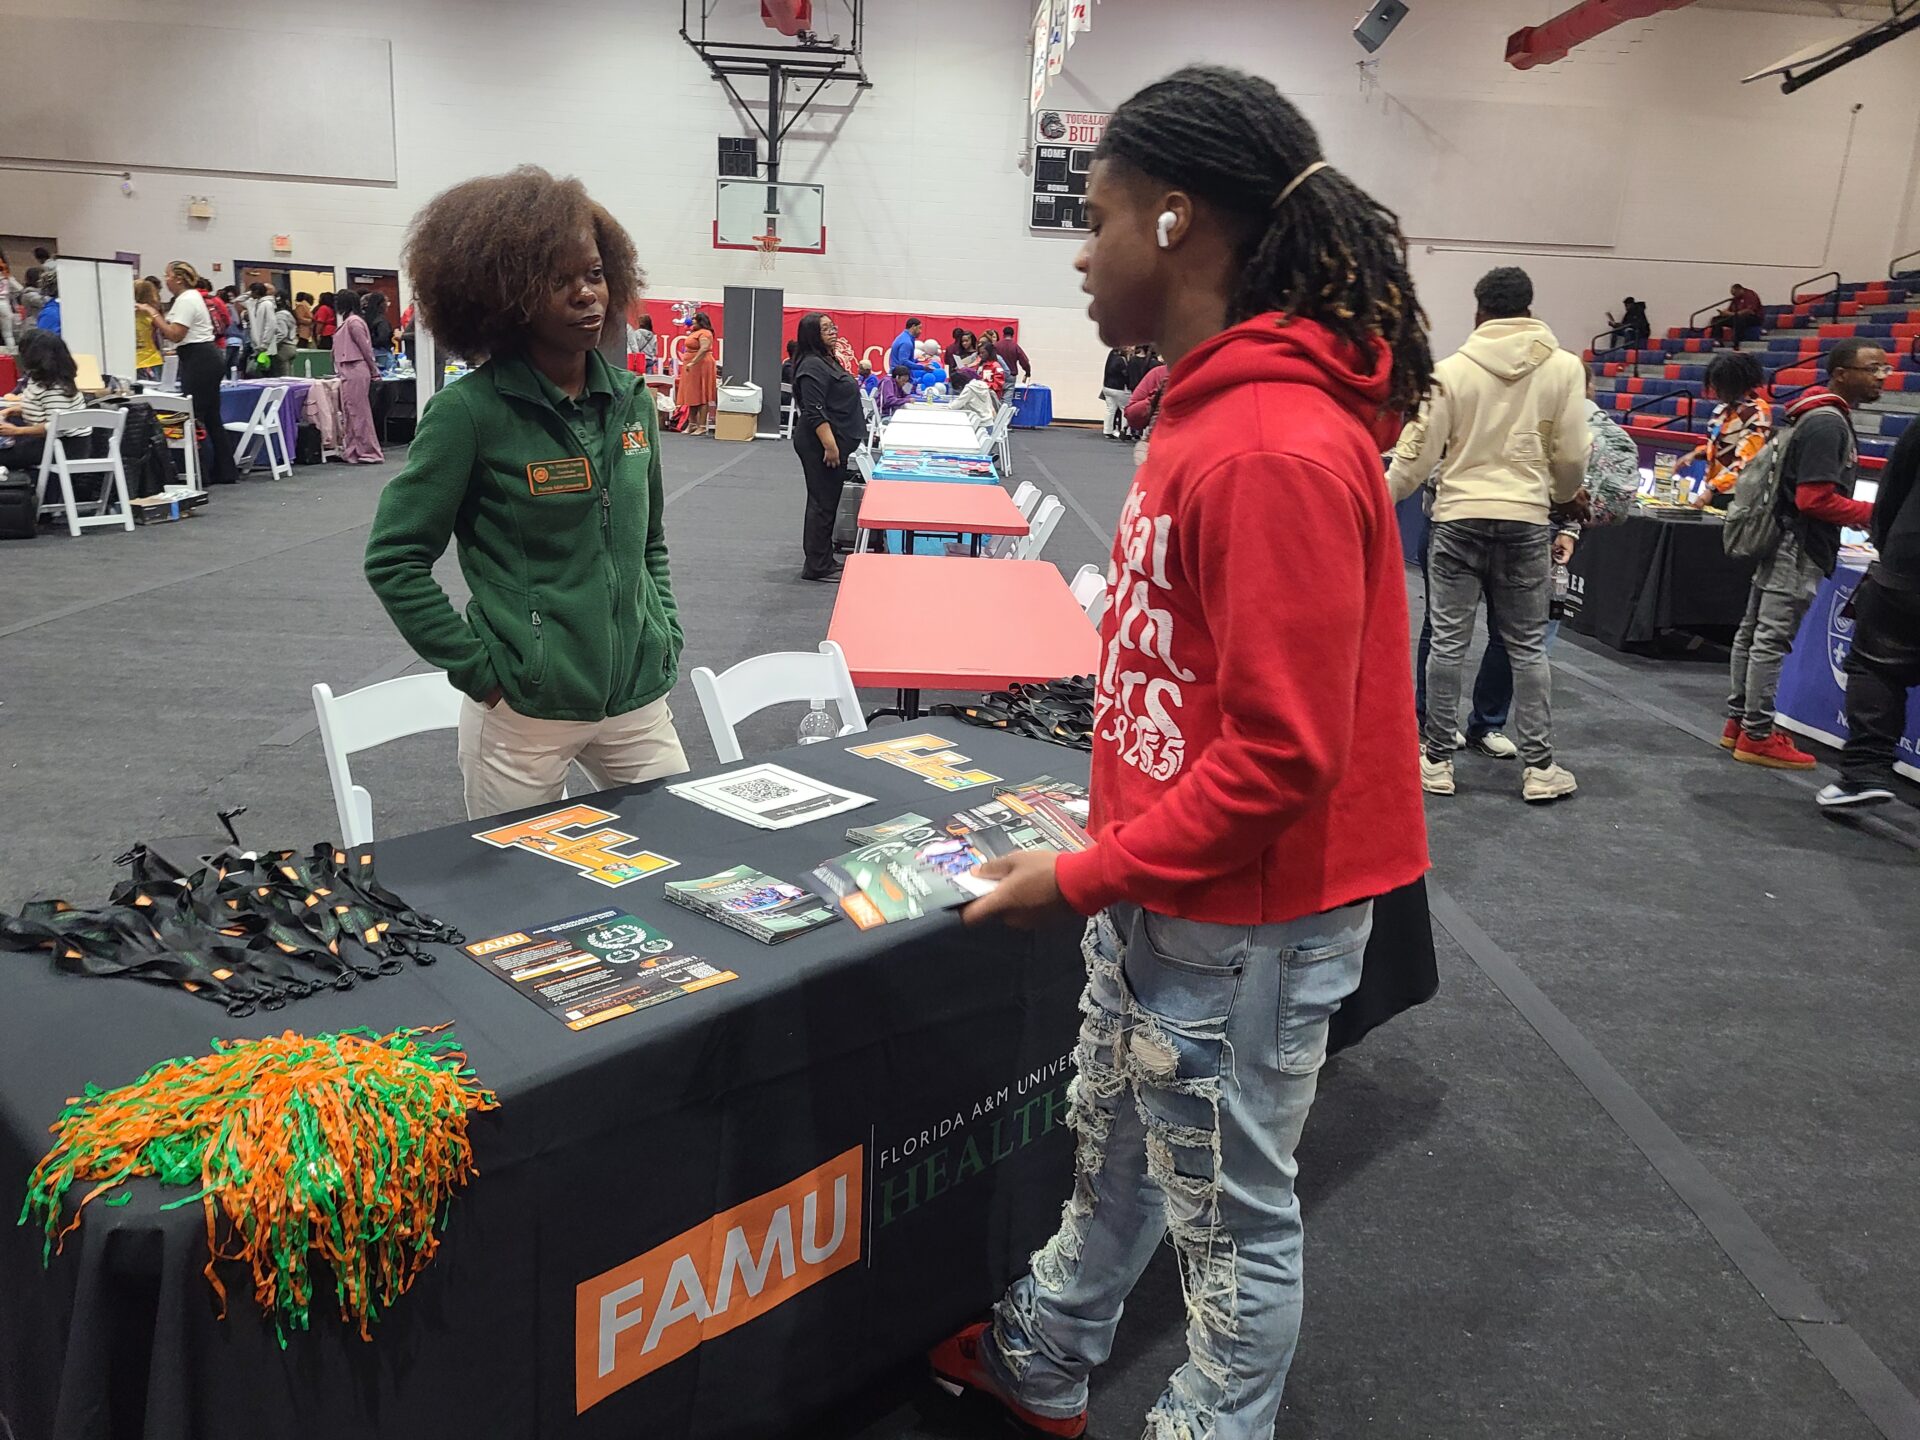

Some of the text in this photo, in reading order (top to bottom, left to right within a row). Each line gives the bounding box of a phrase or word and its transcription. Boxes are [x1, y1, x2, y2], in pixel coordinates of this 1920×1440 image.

[1040, 148, 1066, 158] HOME
[1035, 195, 1056, 203] FOULS
[472, 934, 525, 954] FAMU
[637, 957, 693, 978] NOVEMBER
[880, 1050, 1078, 1169] FLORIDA A&M UNIVER
[879, 1079, 1073, 1229] HEALTH
[598, 1173, 847, 1379] FAMU
